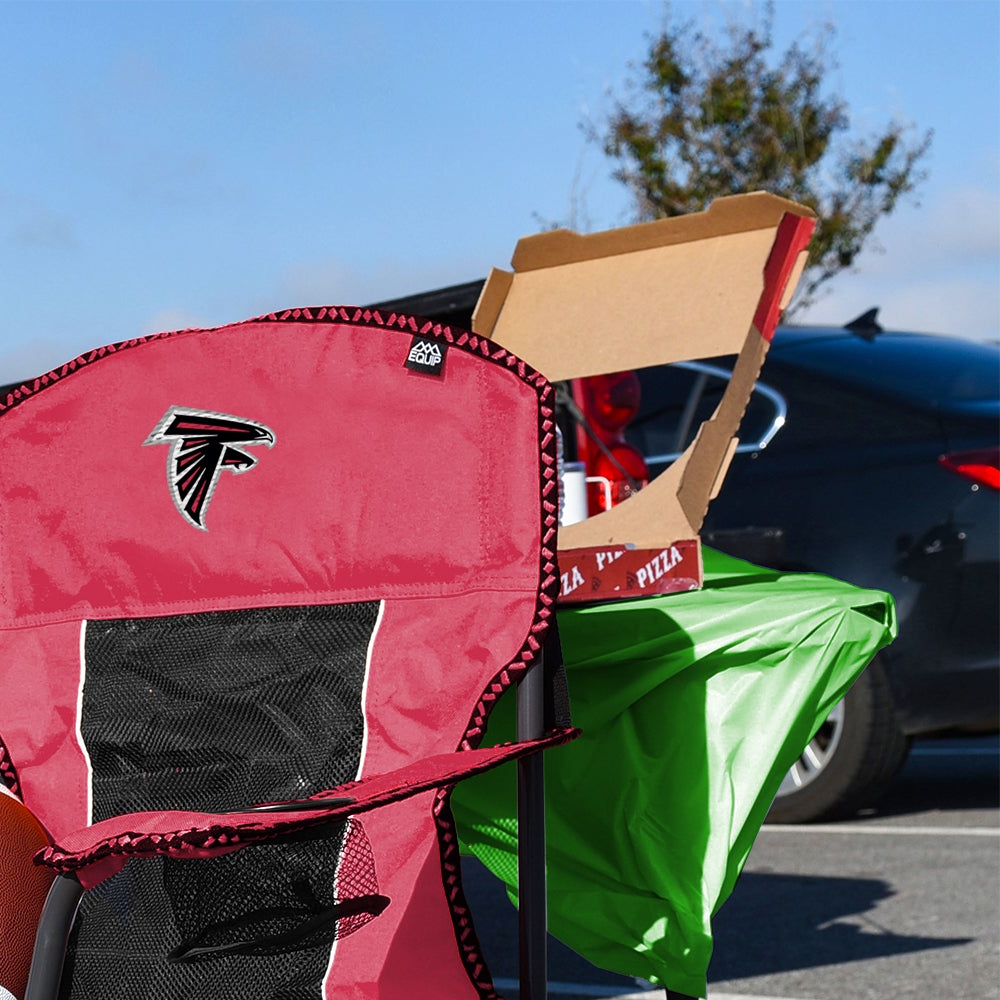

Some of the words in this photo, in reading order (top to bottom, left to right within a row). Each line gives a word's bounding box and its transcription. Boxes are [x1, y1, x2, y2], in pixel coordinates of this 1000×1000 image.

[408, 350, 441, 366] EQUIP
[560, 565, 585, 596] ZA
[635, 546, 684, 588] PIZZA
